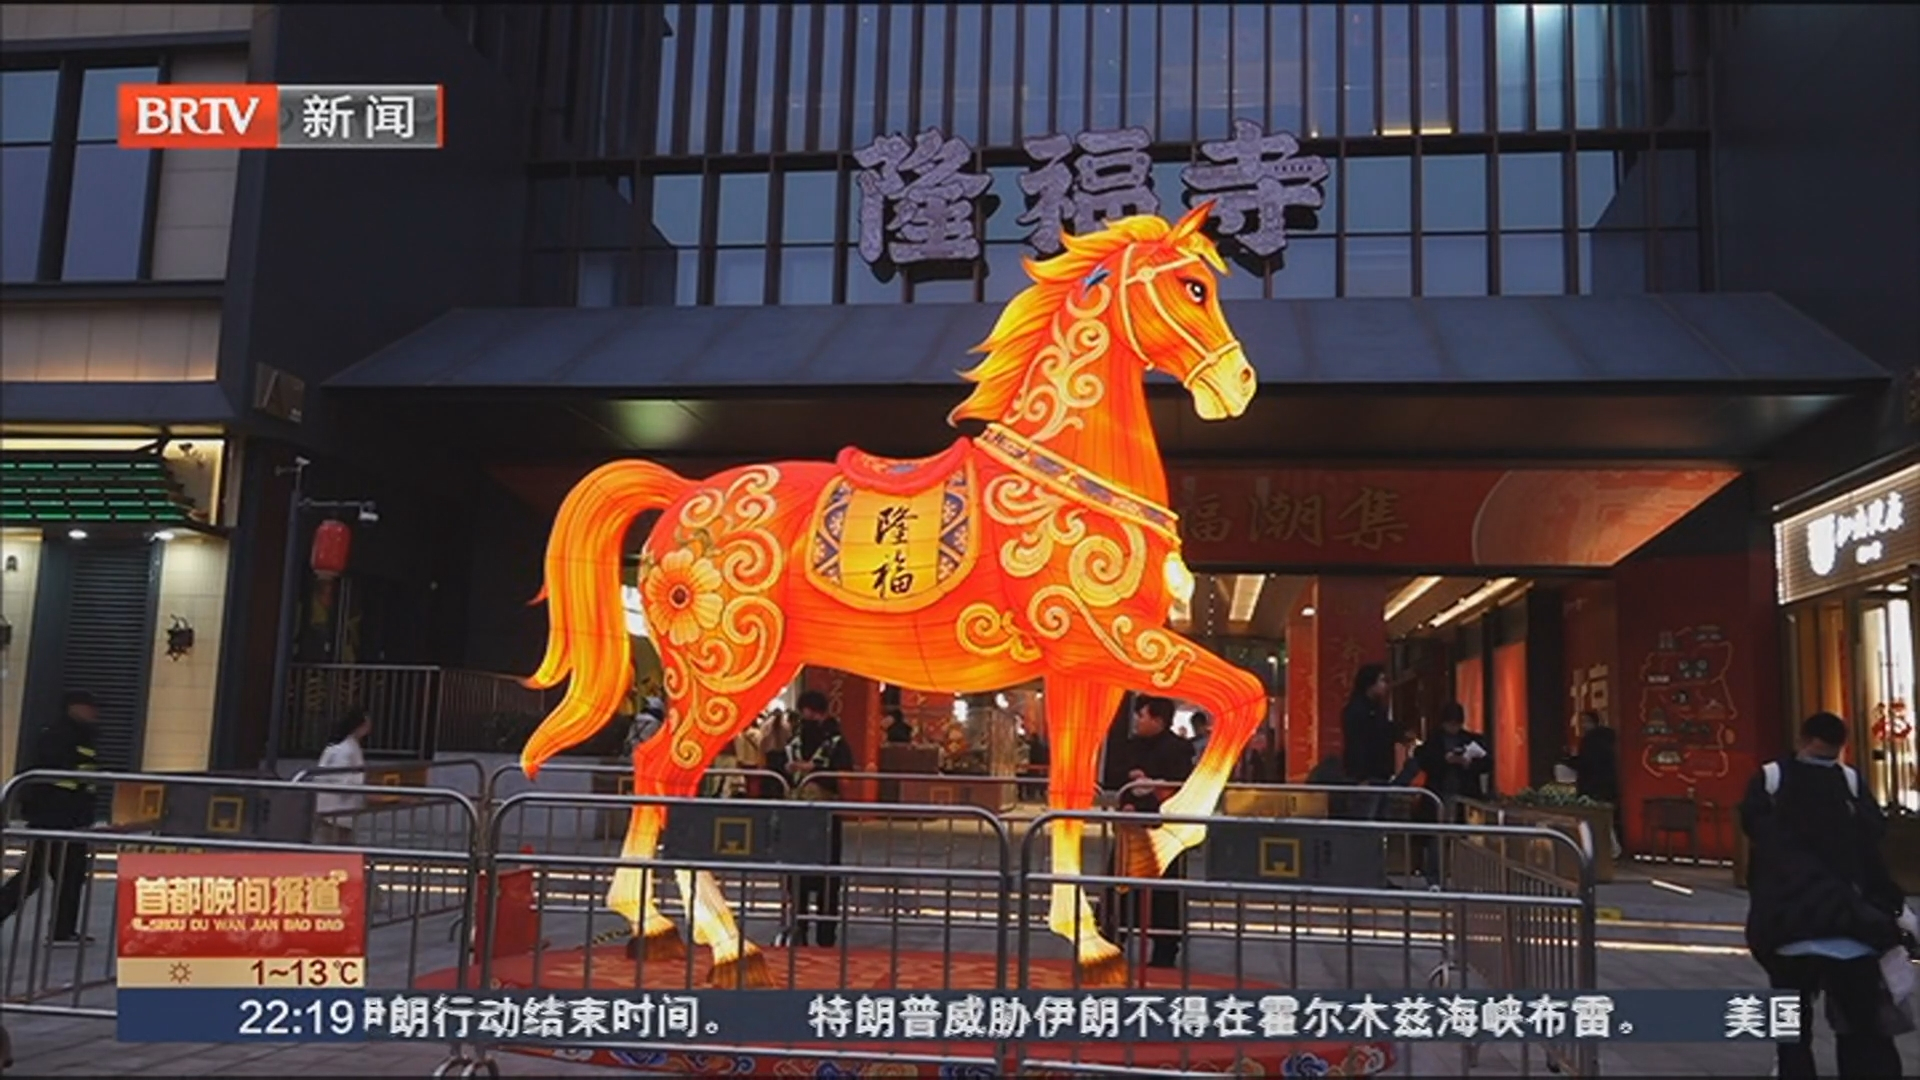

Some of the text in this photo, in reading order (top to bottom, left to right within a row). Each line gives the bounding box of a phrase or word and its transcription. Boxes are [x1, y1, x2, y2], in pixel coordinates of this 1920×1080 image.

[853, 118, 1329, 264] 隆福寺
[871, 506, 919, 600] 隆福
